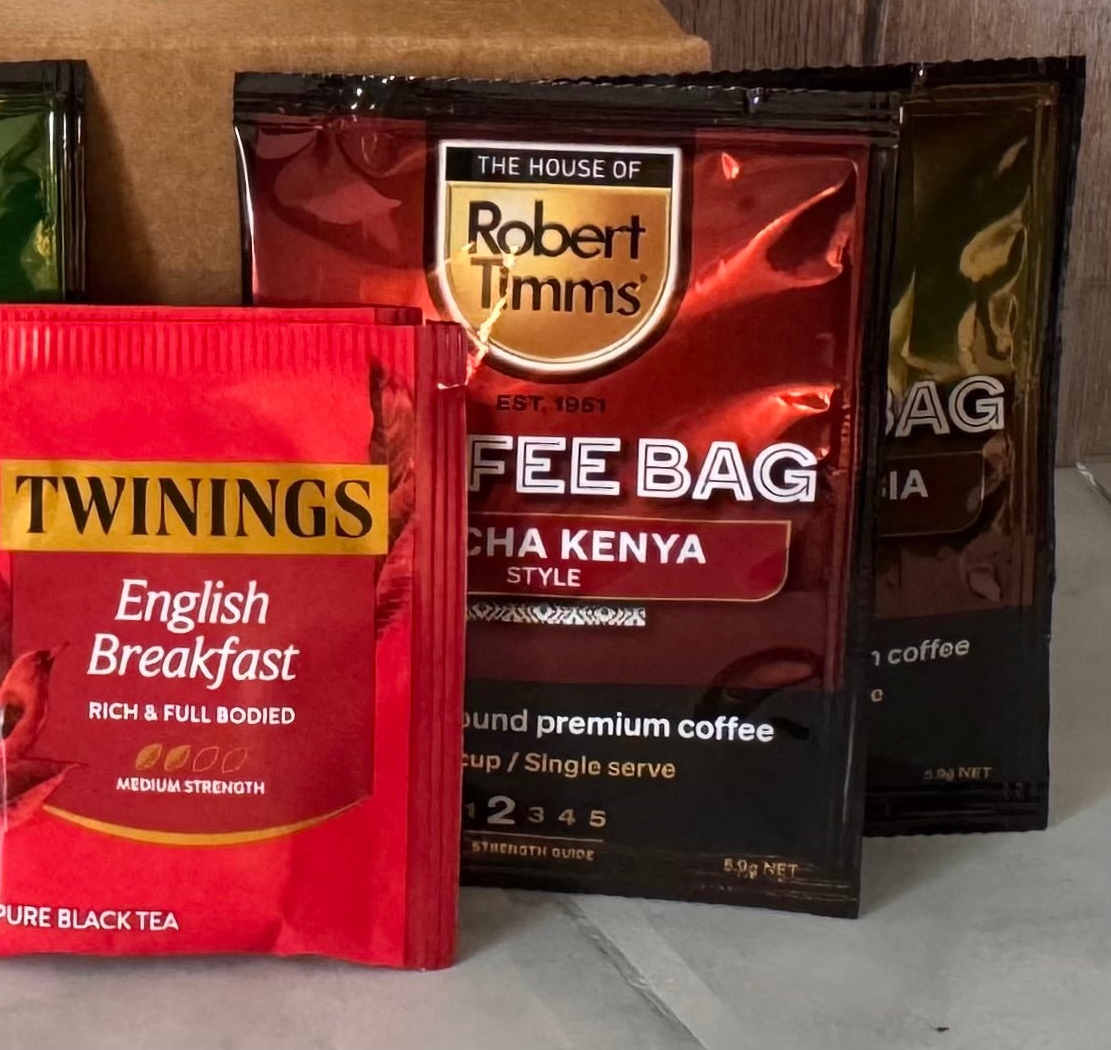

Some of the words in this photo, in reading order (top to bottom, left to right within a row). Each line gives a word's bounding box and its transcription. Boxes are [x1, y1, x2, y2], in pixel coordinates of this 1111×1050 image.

[478, 156, 520, 176] THE
[530, 158, 606, 179] HOUSE
[613, 160, 642, 179] OF
[467, 199, 647, 260] Robert
[886, 375, 1006, 438] AG
[637, 438, 819, 502] BAG
[15, 475, 374, 539] TWININGS
[561, 529, 706, 564] KENYA
[506, 566, 581, 588] STYLE
[114, 578, 270, 634] English
[86, 632, 301, 691] Breakfast
[888, 638, 970, 664] coffee
[89, 701, 138, 720] RICH
[144, 704, 158, 721] &
[164, 704, 211, 723] FULL
[216, 707, 296, 725] BODIED
[536, 712, 671, 739] premium
[677, 716, 776, 743] coffee
[524, 753, 601, 778] Single
[608, 762, 677, 779] serve
[116, 777, 181, 794] MEDIUM
[184, 779, 265, 794] STRENGTH
[487, 795, 516, 825] 2
[528, 806, 545, 823] 3
[558, 808, 577, 827] 4
[589, 810, 607, 827] 5
[58, 907, 132, 931] BLACK
[136, 911, 180, 931] TEA
